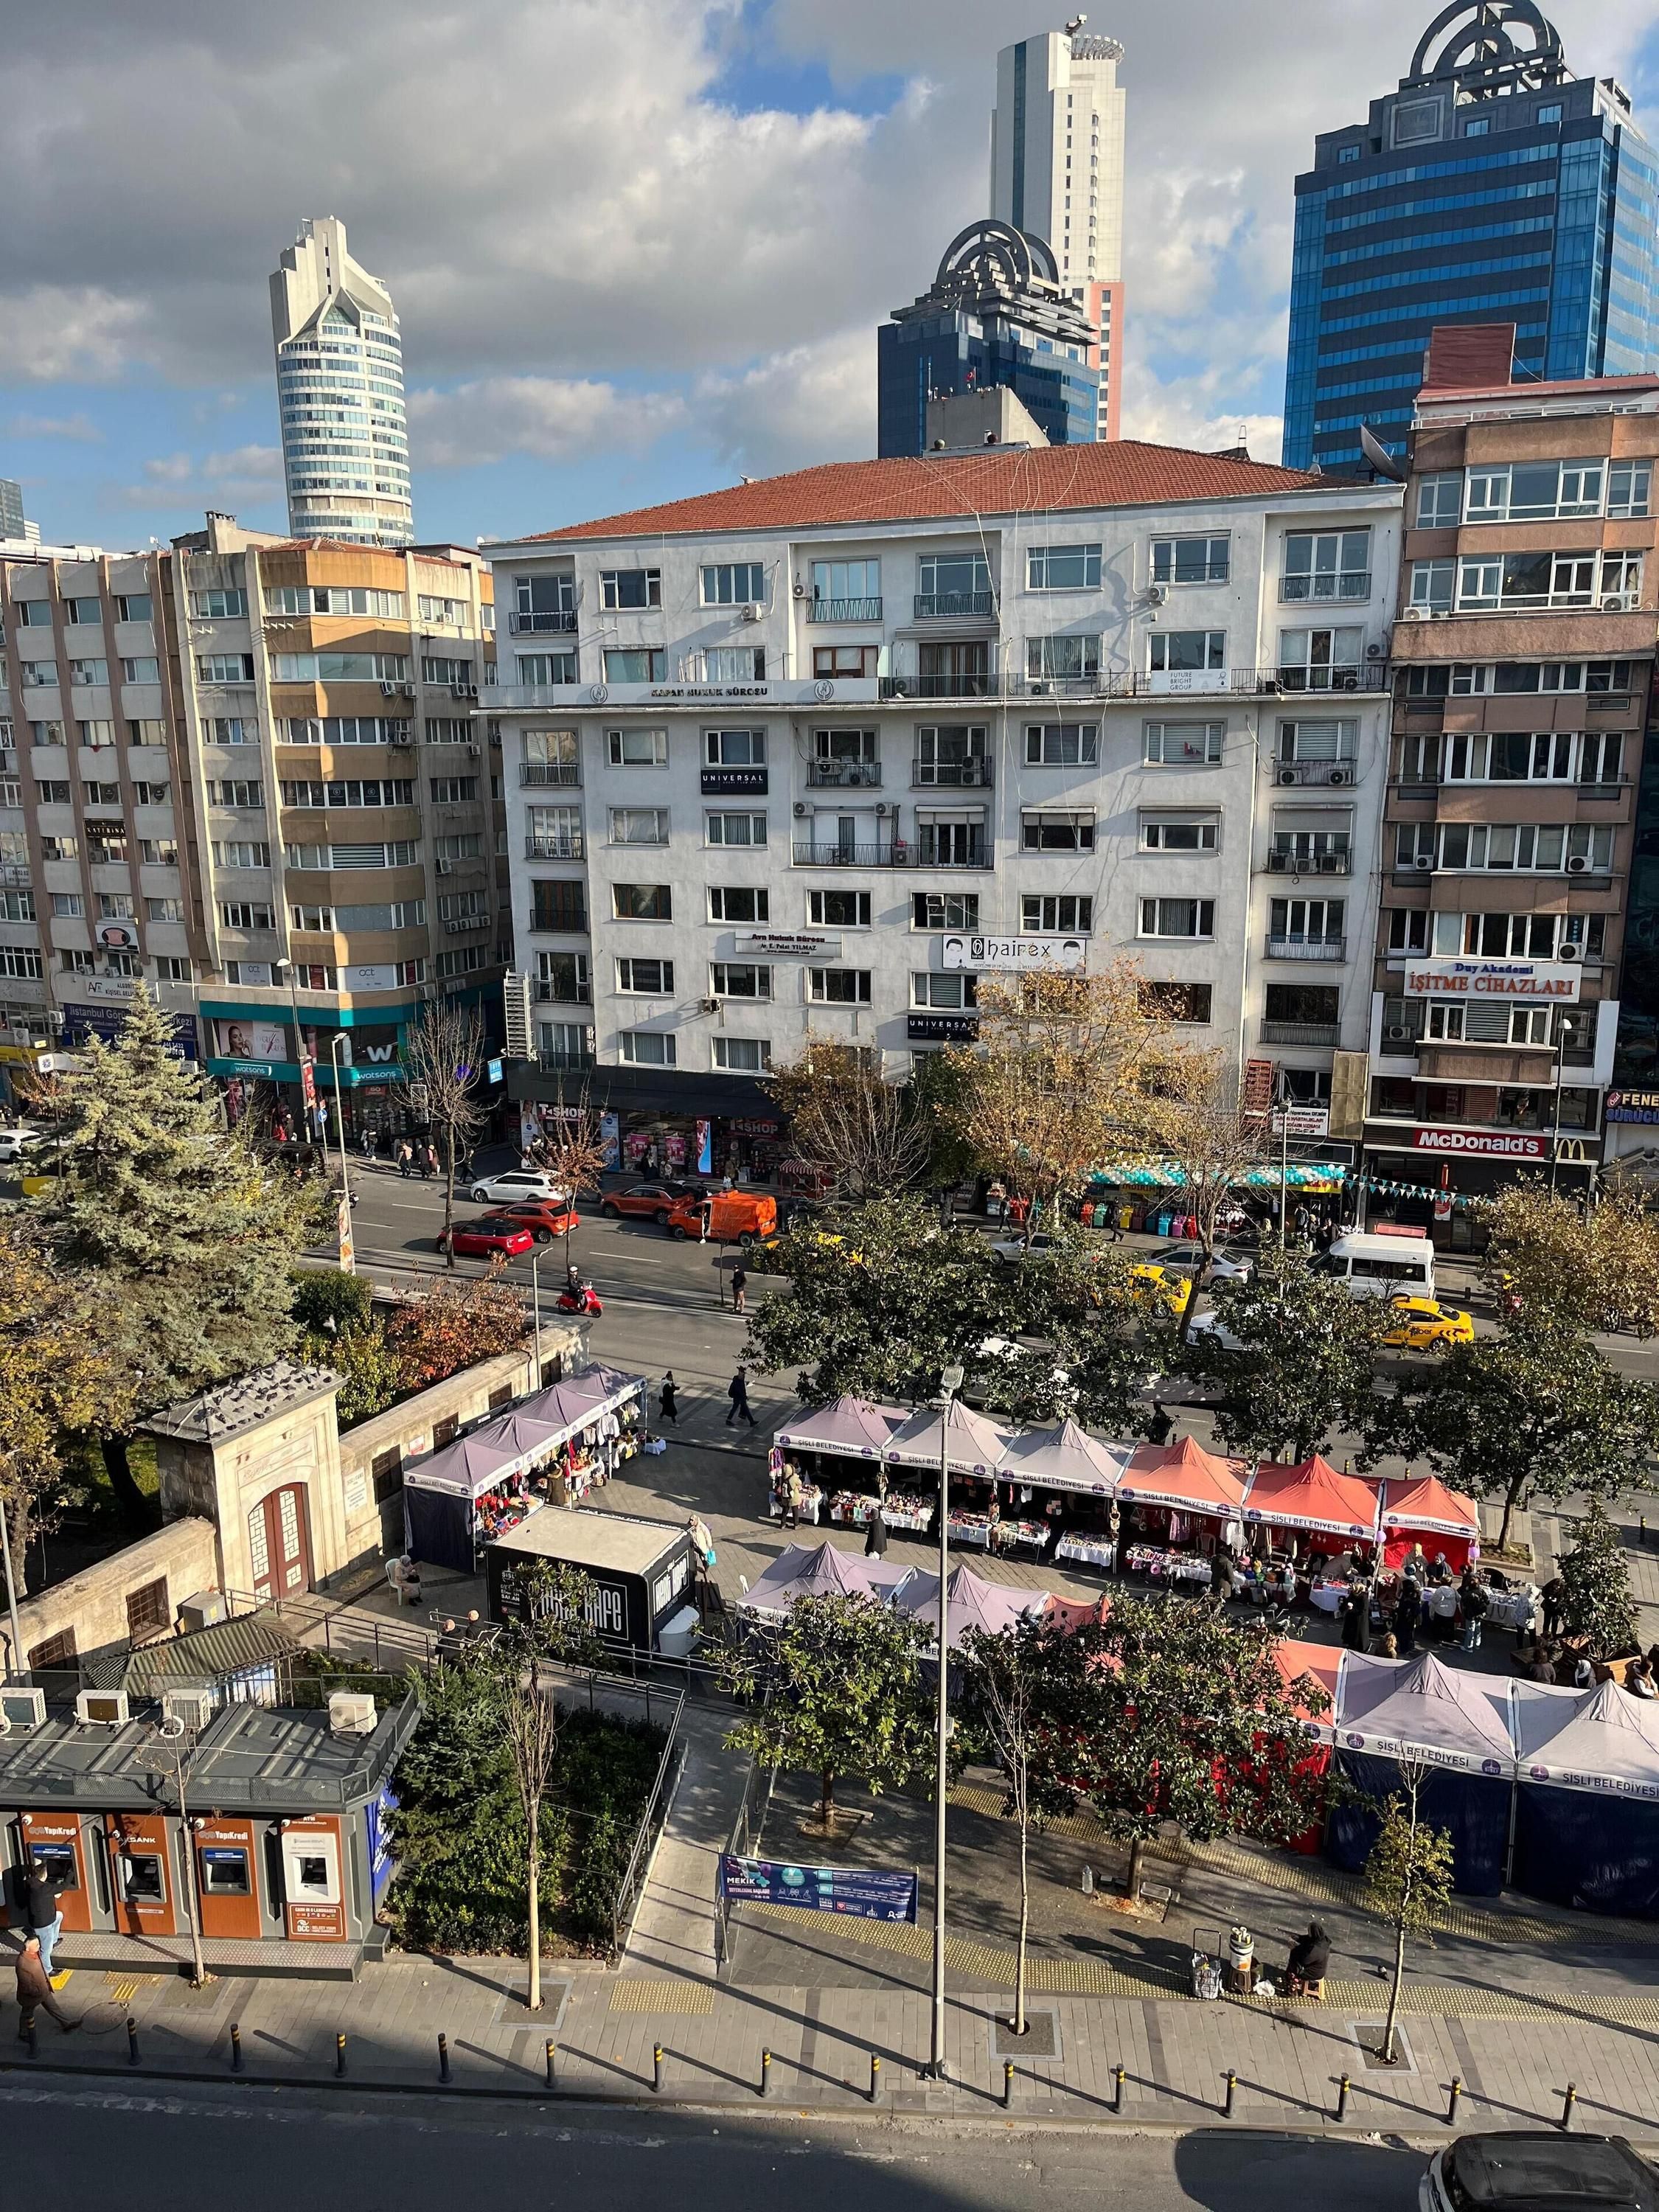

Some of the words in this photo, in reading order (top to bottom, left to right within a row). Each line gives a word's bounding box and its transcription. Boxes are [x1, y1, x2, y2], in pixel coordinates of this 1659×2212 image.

[726, 686, 768, 696] BÜROSU
[1455, 963, 1478, 974] Duy
[1481, 964, 1534, 974] Akademi
[1409, 971, 1469, 992] İŞİTME
[1474, 974, 1575, 995] CİHAZLARI
[235, 1065, 266, 1074] watsons
[357, 1071, 397, 1080] watsons
[1419, 1131, 1540, 1154] McDonald's
